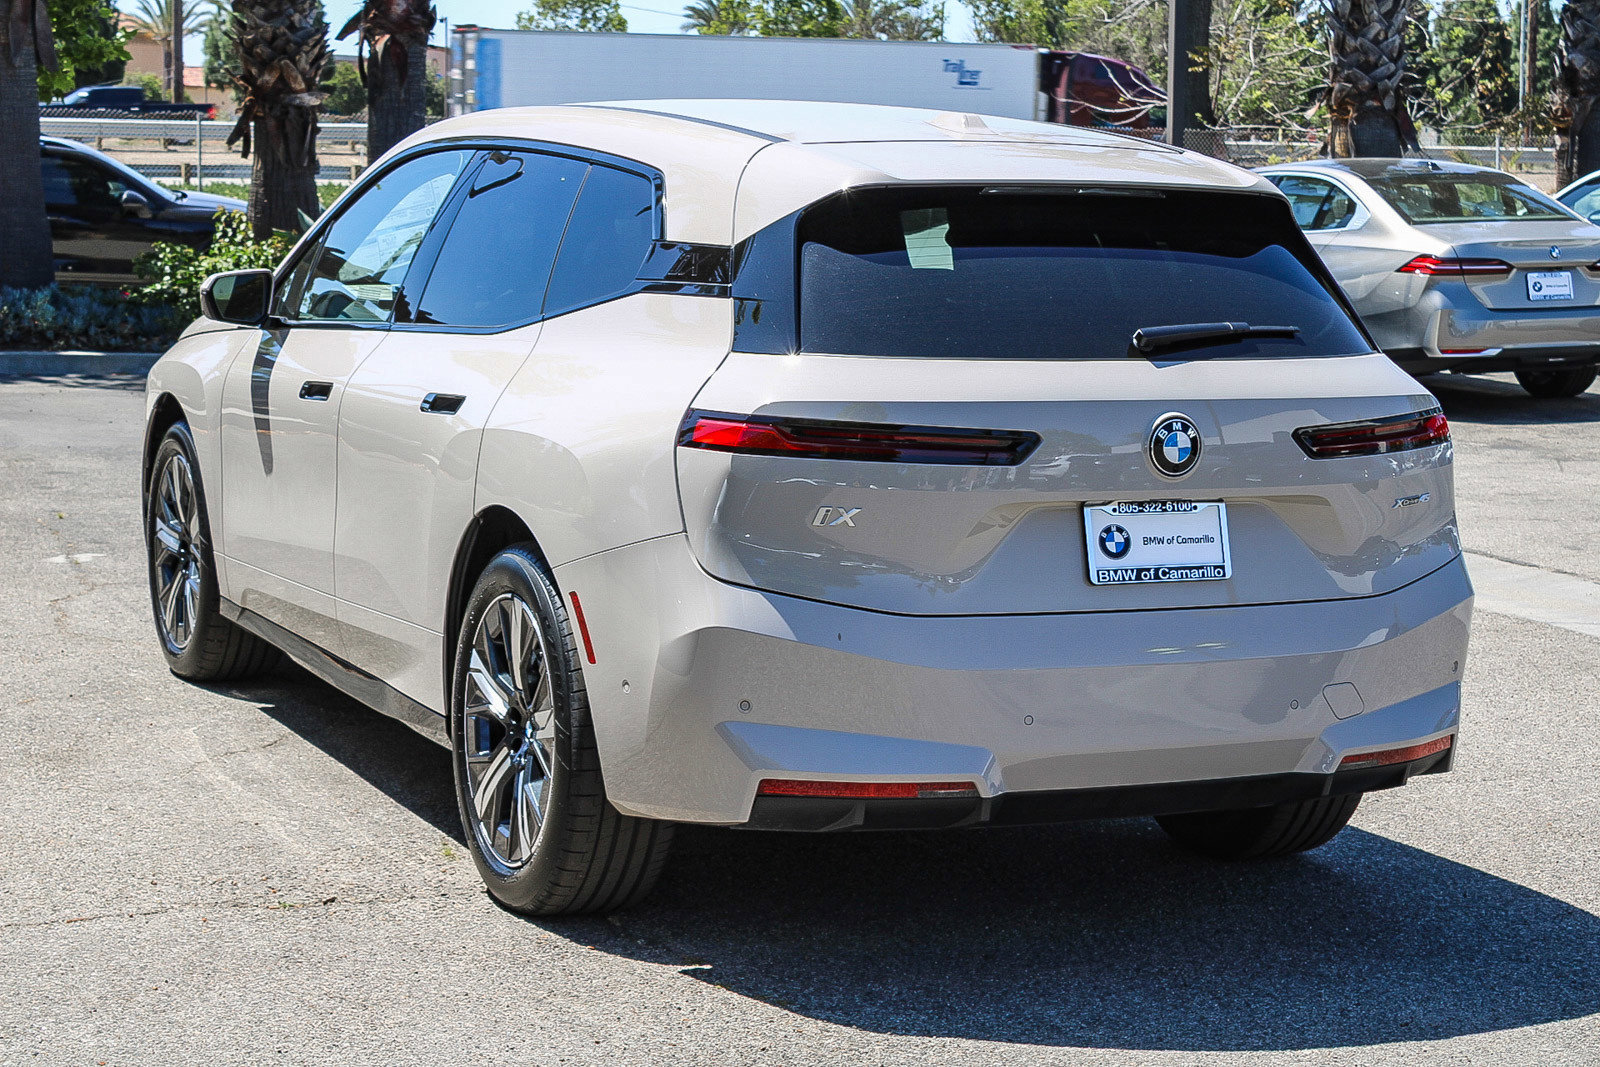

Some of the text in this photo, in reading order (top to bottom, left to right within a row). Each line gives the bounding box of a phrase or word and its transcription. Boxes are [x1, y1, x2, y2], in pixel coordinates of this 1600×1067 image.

[1158, 422, 1196, 439] BMW
[1119, 502, 1191, 513] 805-322-6100
[1101, 525, 1129, 539] BMW
[1142, 534, 1215, 546] BMW of Camarillo
[1098, 566, 1223, 582] BMW of Camarillo
